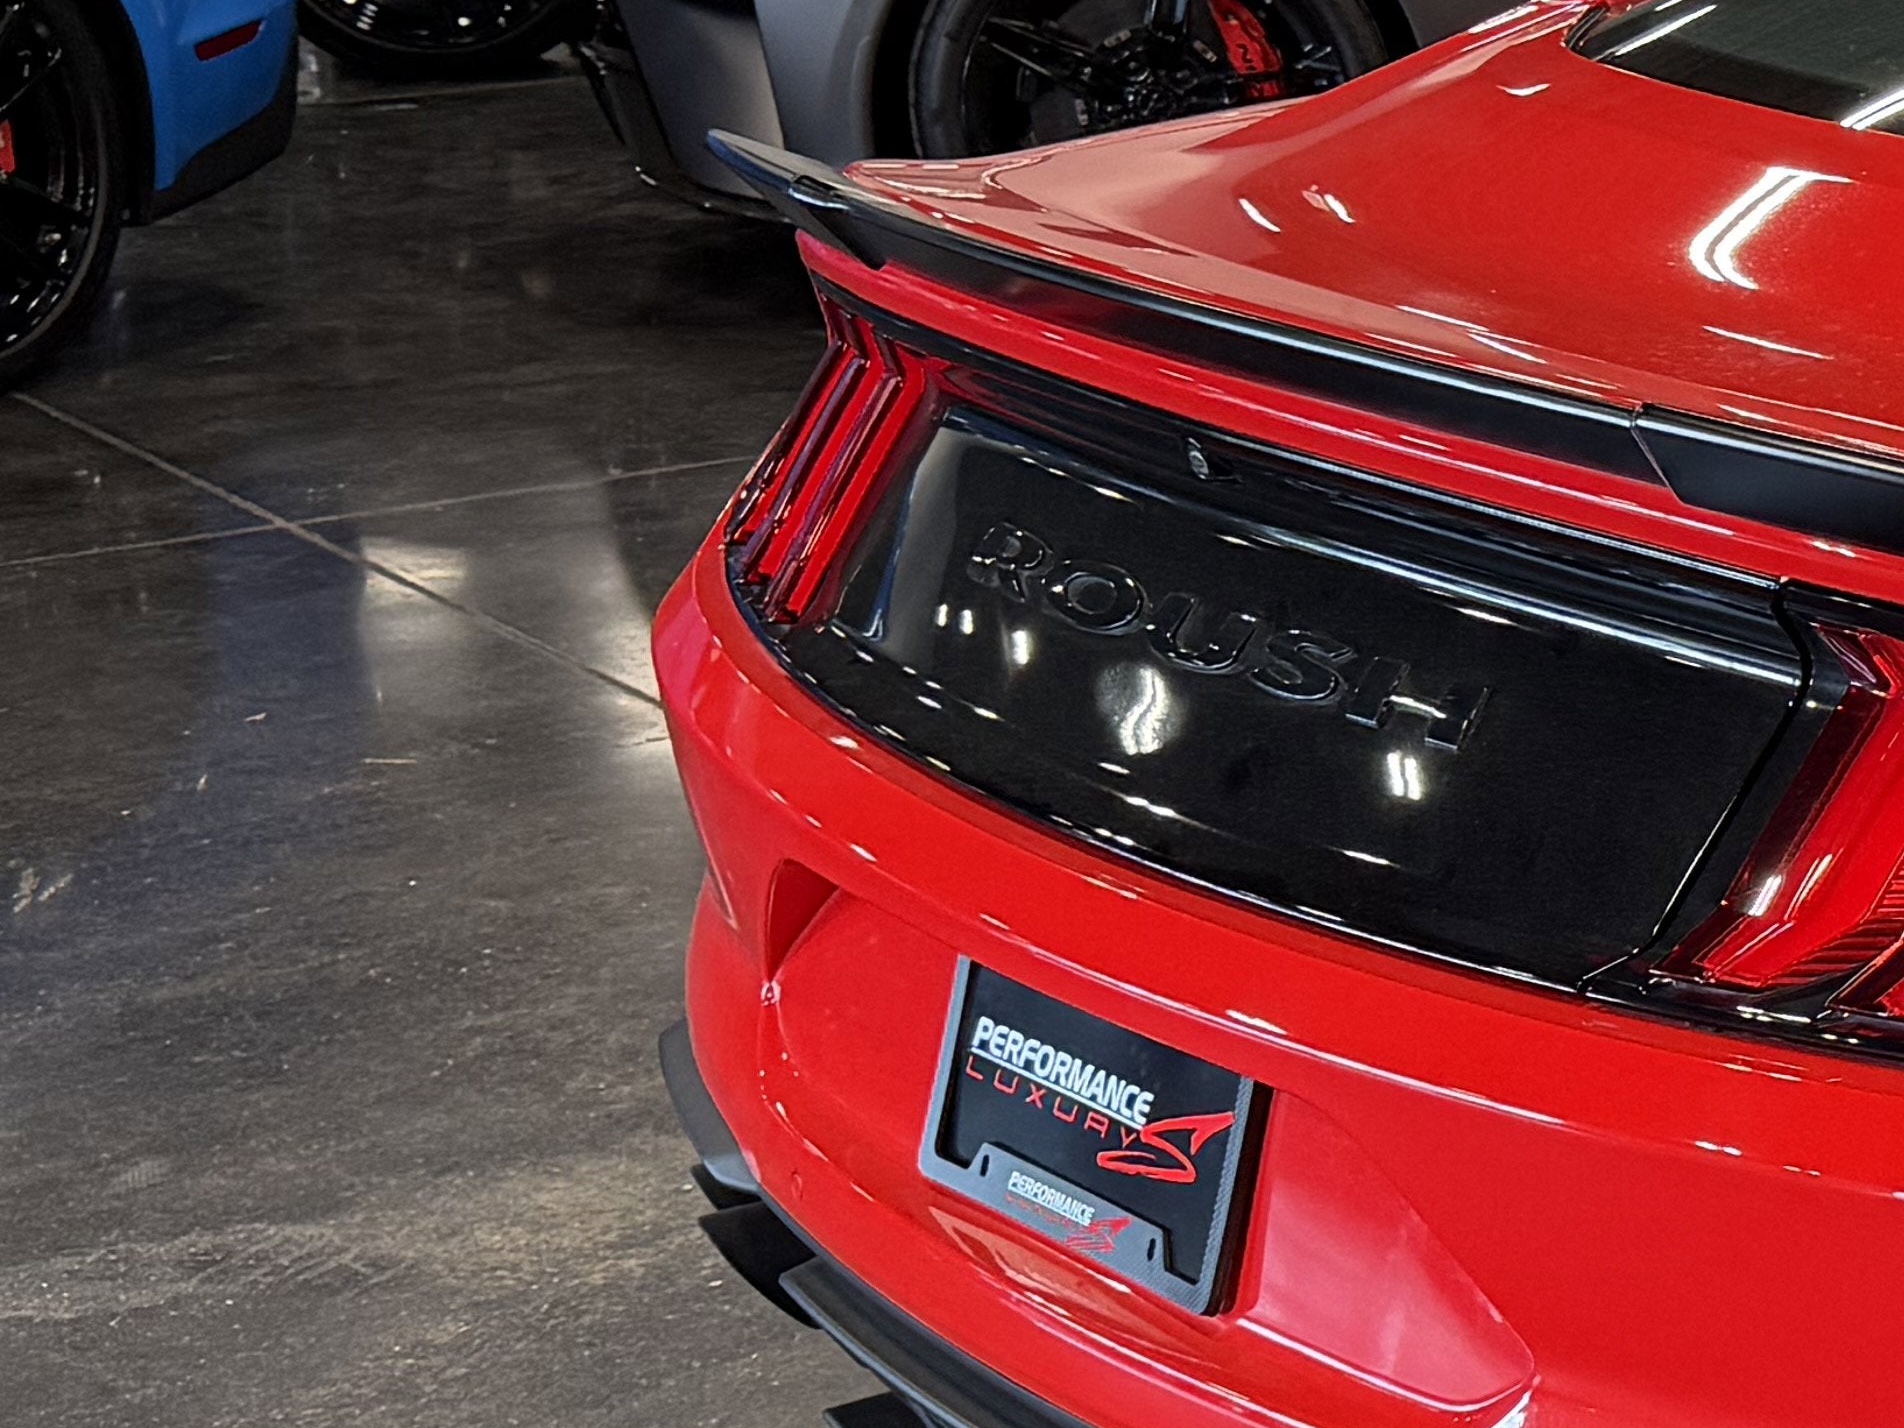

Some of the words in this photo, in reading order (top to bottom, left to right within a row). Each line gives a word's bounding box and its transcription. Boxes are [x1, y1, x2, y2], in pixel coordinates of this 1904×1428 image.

[965, 521, 1496, 751] ROUSH
[965, 1054, 1137, 1148] LUXURY
[971, 1015, 1155, 1126] PERFORMANCE
[1007, 1170, 1096, 1226] PERFORMANCE
